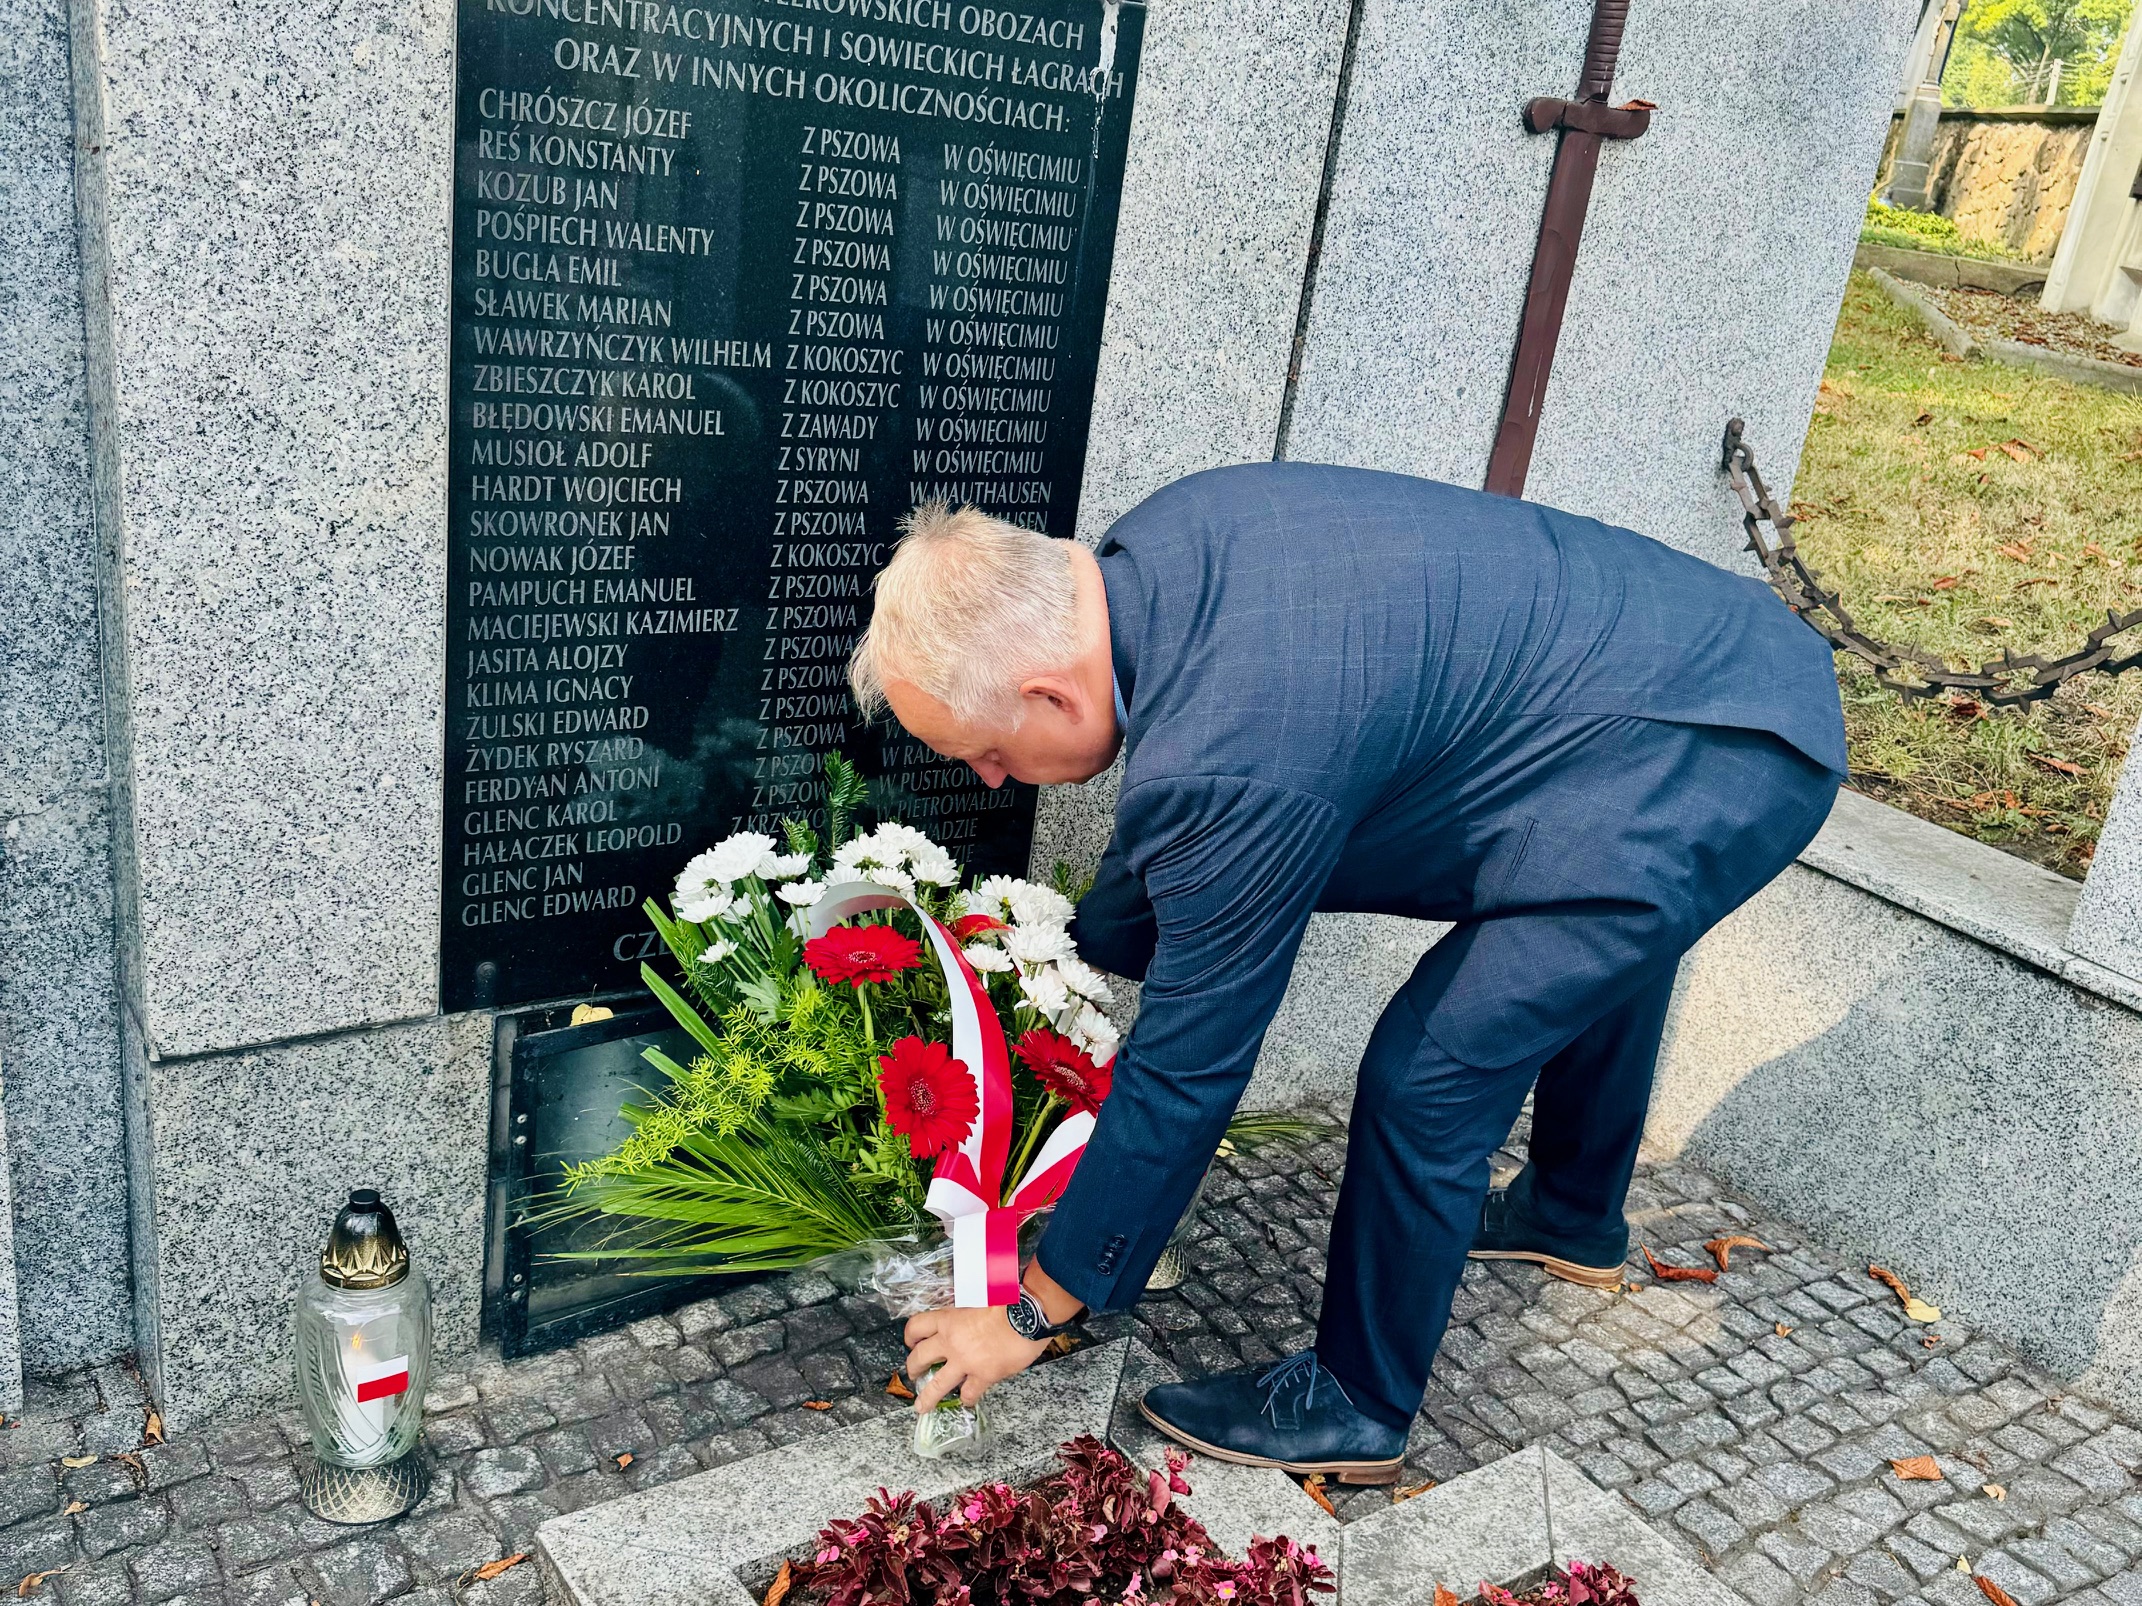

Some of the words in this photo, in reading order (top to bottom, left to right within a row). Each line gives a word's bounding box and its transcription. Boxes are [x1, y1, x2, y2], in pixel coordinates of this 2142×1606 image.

[959, 5, 1084, 51] OBOZACH
[554, 37, 642, 80] ORAZ
[651, 50, 683, 83] W
[692, 56, 806, 99] INNYCH
[814, 72, 1070, 133] OKOLICZNOŚCIACH:
[823, 28, 831, 58] I
[839, 30, 1005, 82] SOWIECKICH
[1011, 56, 1124, 99] ŁAGRACH
[479, 85, 618, 132] CHRÓSZCZ
[623, 97, 692, 139] JÓZEF
[801, 125, 816, 154] Z
[820, 128, 901, 165] PSZOWA
[944, 143, 964, 172] W
[967, 141, 1081, 184] OŚWIĘCIMIU
[479, 123, 521, 162] REŚ
[529, 134, 676, 177] KONSTANTY
[798, 163, 813, 191] Z
[817, 165, 897, 200] PSZOWA
[940, 179, 960, 207] W
[963, 177, 1077, 218] OŚWIĘCIMIU
[478, 170, 566, 205] KOZUB
[574, 178, 619, 213] JAN
[796, 200, 810, 228] Z
[814, 202, 894, 236] PSZOWA
[936, 214, 957, 241] W
[960, 213, 1072, 252] OŚWIĘCIMIU
[477, 204, 597, 247] POŚPIECH
[603, 220, 715, 256] WALENTY
[793, 237, 808, 264] Z
[811, 238, 891, 271] PSZOWA
[933, 250, 953, 275] W
[956, 244, 1068, 285] OŚWIĘCIMIU
[476, 249, 561, 282] BUGLA
[568, 255, 622, 287] EMIL
[790, 273, 805, 300] Z
[808, 274, 887, 305] PSZOWA
[929, 284, 950, 309] W
[952, 279, 1064, 318] OŚWIĘCIMIU
[474, 287, 570, 321] SŁAWEK
[577, 294, 672, 328] MARIAN
[788, 309, 802, 335] Z
[806, 310, 885, 339] PSZOWA
[926, 318, 946, 342] W
[949, 312, 1060, 350] OŚWIĘCIMIU
[473, 321, 664, 363] WAWRZYŃCZYK
[670, 337, 771, 368] WILHELM
[785, 344, 800, 369] Z
[803, 344, 904, 373] KOKOSZYC
[923, 352, 942, 375] W
[945, 346, 1056, 382] OŚWIĘCIMIU
[473, 364, 615, 397] ZBIESZCZYK
[622, 369, 696, 400] KAROL
[783, 378, 797, 403] Z
[801, 379, 901, 406] KOKOSZYC
[919, 385, 939, 407] W
[942, 379, 1052, 413] OŚWIĘCIMIU
[473, 401, 615, 433] BŁĘDOWSKI
[620, 407, 725, 435] EMANUEL
[780, 412, 794, 437] Z
[797, 413, 879, 438] ZAWADY
[916, 417, 935, 439] W
[938, 412, 1048, 445] OŚWIĘCIMIU
[471, 439, 567, 467] MUSIOŁ
[574, 441, 653, 468] ADOLF
[777, 446, 792, 470] Z
[795, 446, 860, 470] SYRYNI
[913, 449, 932, 471] W
[935, 444, 1044, 475] OŚWIĘCIMIU
[472, 475, 556, 502] HARDT
[562, 476, 682, 508] WOJCIECH
[775, 479, 789, 502] Z
[793, 479, 869, 502] PSZOWA
[910, 481, 929, 502] W
[932, 481, 1052, 502] MAUTHAUSEN
[470, 510, 624, 537] SKOWRONEK
[629, 511, 670, 541] JAN
[772, 511, 787, 535] Z
[790, 511, 866, 534] PSZOWA
[470, 546, 564, 572] NOWAK
[570, 540, 636, 576] JÓZEF
[770, 544, 784, 566] Z
[787, 542, 885, 566] KOKOSZYC
[469, 579, 585, 607] PAMPUCH
[593, 577, 696, 604] EMANUEL
[767, 575, 781, 598] Z
[785, 574, 860, 597] PSZOWA
[467, 611, 619, 643] MACIEJEWSKI
[626, 608, 740, 635] KAZIMIERZ
[765, 606, 779, 629] Z
[783, 604, 857, 628] PSZOWA
[467, 647, 540, 680] JASITA
[545, 643, 629, 673] ALOJZY
[763, 637, 776, 660] Z
[780, 634, 853, 659] PSZOWA
[467, 680, 539, 708] KLIMA
[546, 675, 634, 703] IGNACY
[760, 668, 774, 690] Z
[777, 664, 851, 688] PSZOWA
[553, 705, 649, 734] EDWARD
[758, 698, 771, 720] Z
[775, 693, 848, 719] PSZOWA
[464, 743, 540, 773] ŻYDEK
[546, 735, 644, 767] RYSZARD
[756, 725, 769, 750] Z
[773, 722, 846, 749] PSZOWA
[465, 772, 567, 804] FERDYAN
[573, 763, 661, 795] ANTONI
[754, 757, 767, 779] Z
[882, 746, 899, 767] W
[464, 805, 540, 836] GLENC
[547, 799, 618, 828] KAROL
[752, 786, 764, 807] Z
[879, 774, 896, 794] W
[900, 767, 984, 793] PUSTKOW
[464, 832, 579, 867] HAŁACZEK
[586, 822, 682, 854] LEOPOLD
[876, 805, 892, 821] W
[898, 789, 1015, 819] PIETROWAŁDZI
[462, 866, 538, 897] GLENC
[543, 861, 583, 892] JAN
[461, 896, 536, 927] GLENC
[543, 885, 636, 917] EDWARD
